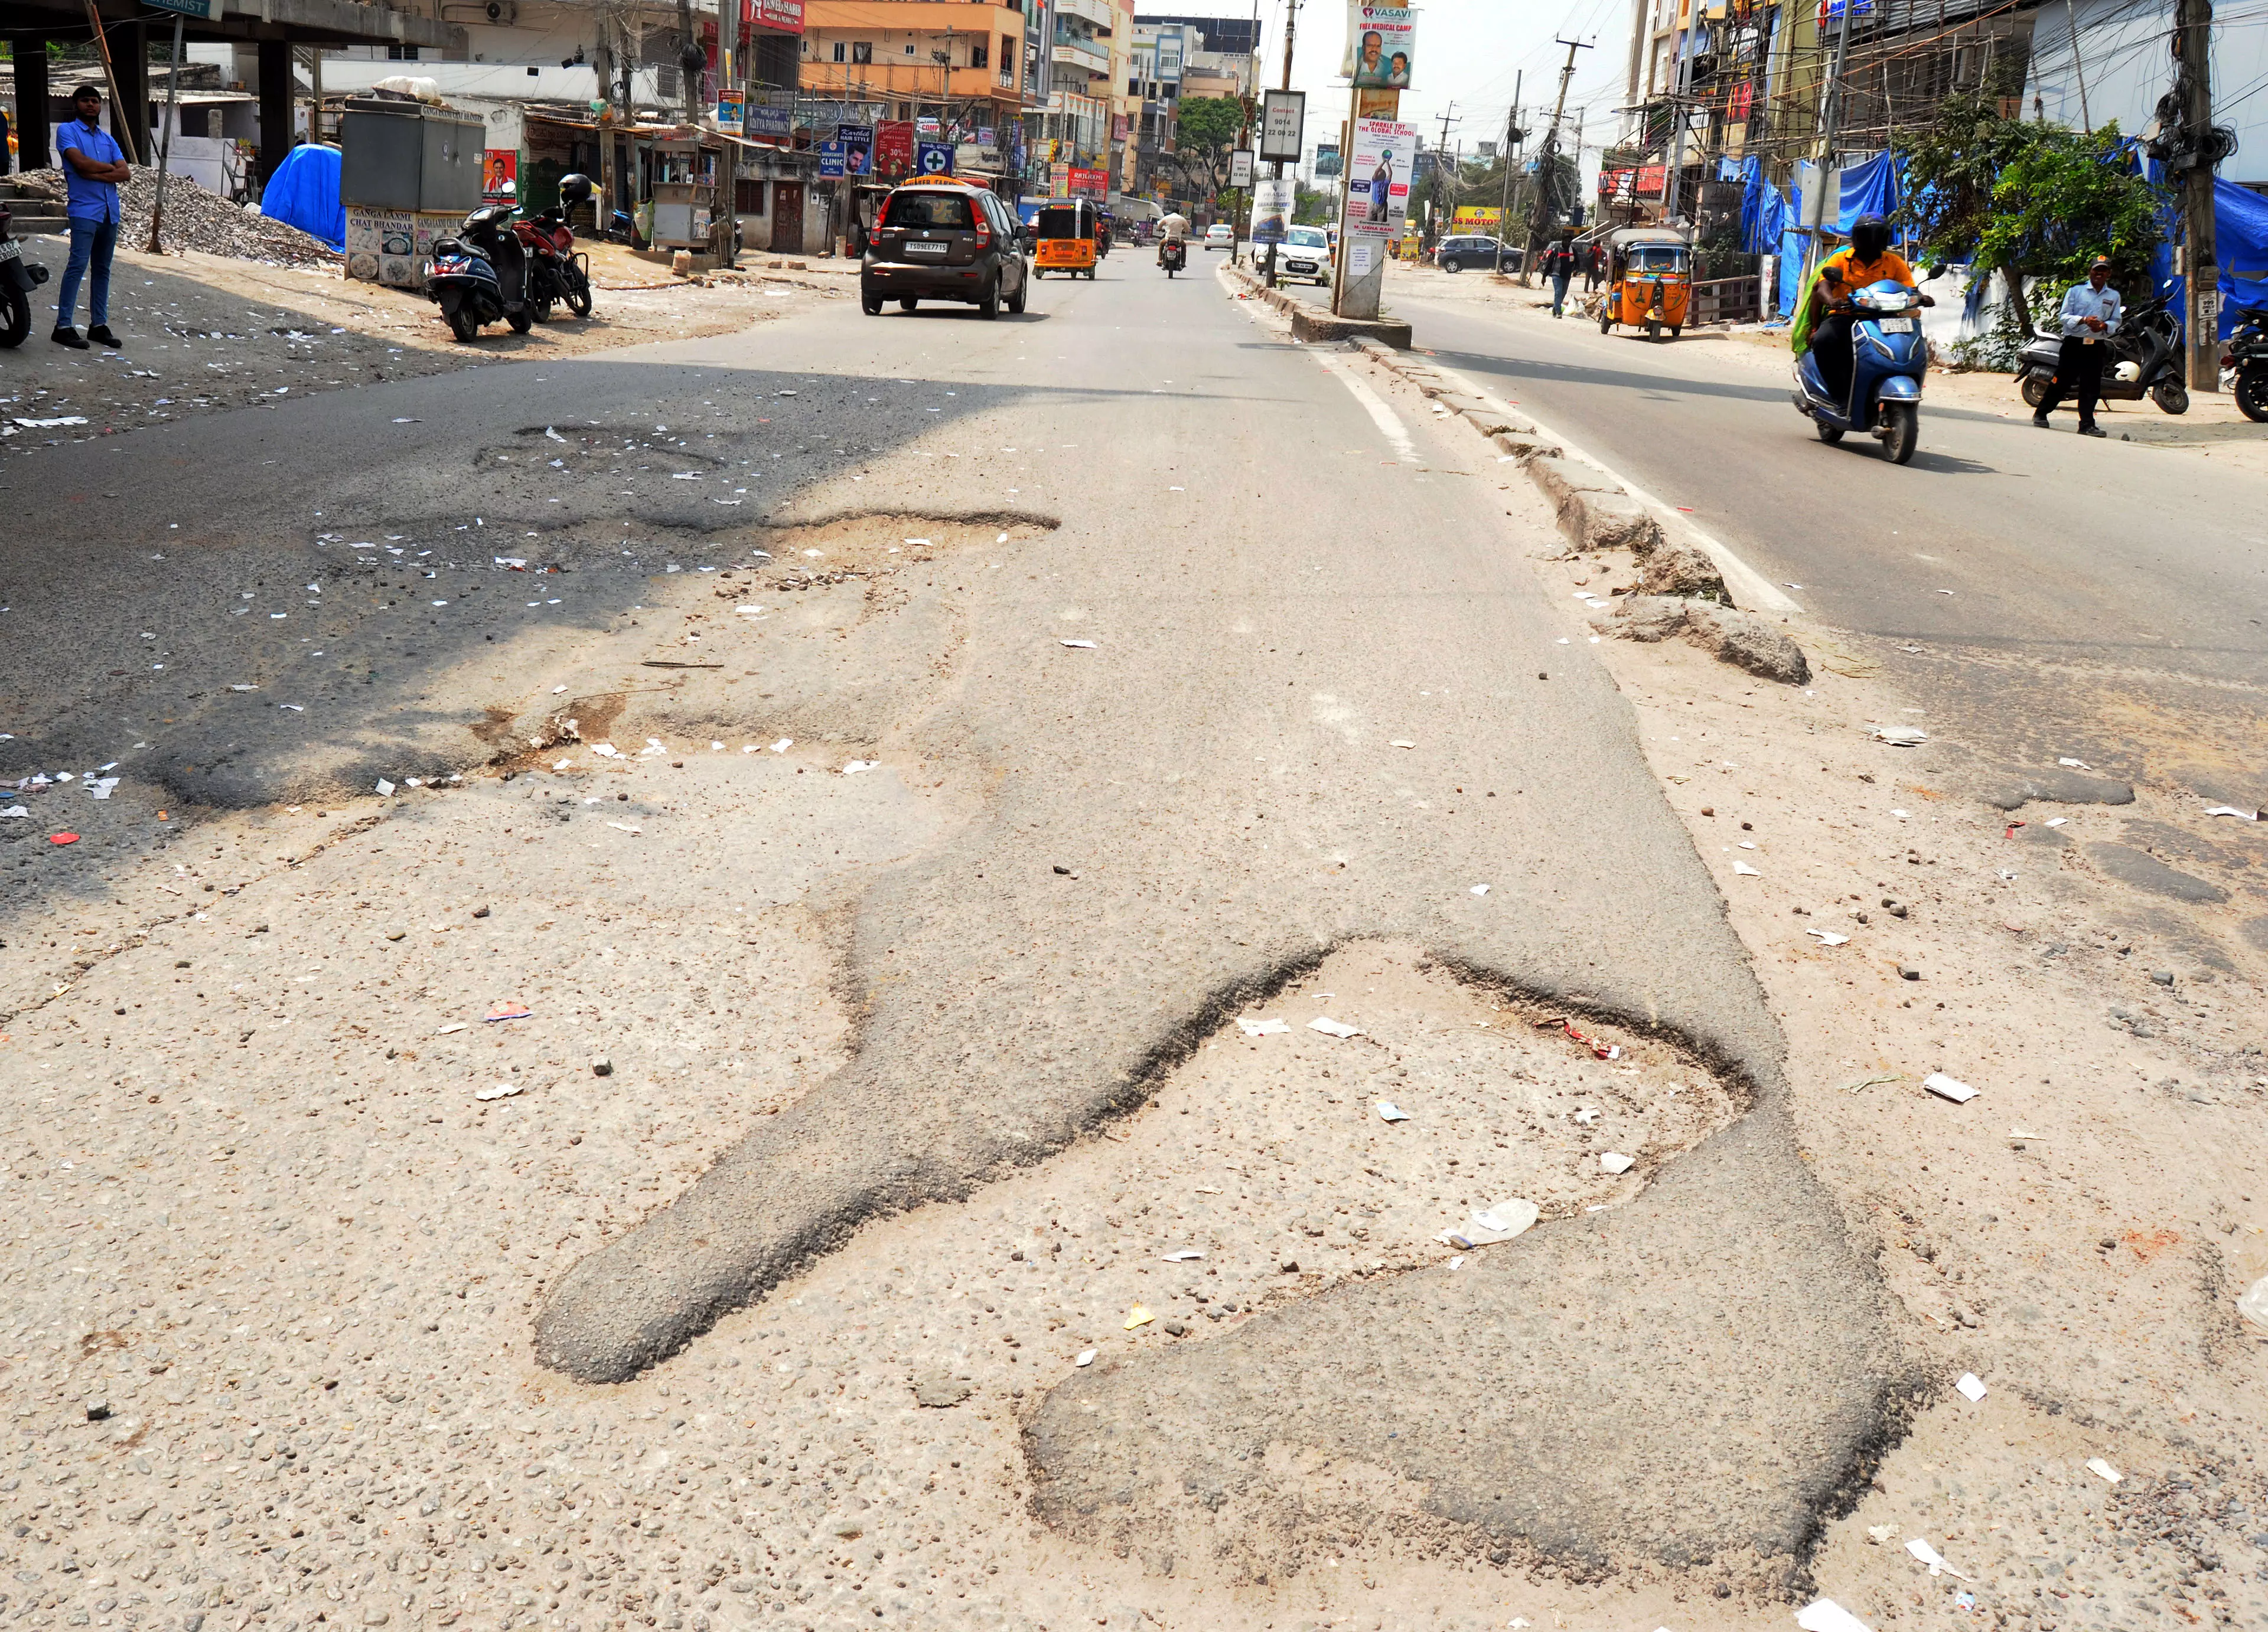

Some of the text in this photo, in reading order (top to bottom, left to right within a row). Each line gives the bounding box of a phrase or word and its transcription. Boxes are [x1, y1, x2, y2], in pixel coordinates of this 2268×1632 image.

[150, 0, 204, 12] HEMIST
[784, 2, 801, 17] HABIB
[1374, 8, 1411, 18] VASAVI
[749, 118, 765, 129] ADITYA
[765, 119, 790, 132] PHARMACY
[890, 148, 903, 156] 30%
[821, 158, 843, 166] CLINIC
[1074, 172, 1103, 181] RAJLAXMI
[353, 208, 412, 221] GANGA LAXMI
[350, 218, 413, 231] CHAT BHANDAR
[910, 243, 946, 251] TS09EE7715
